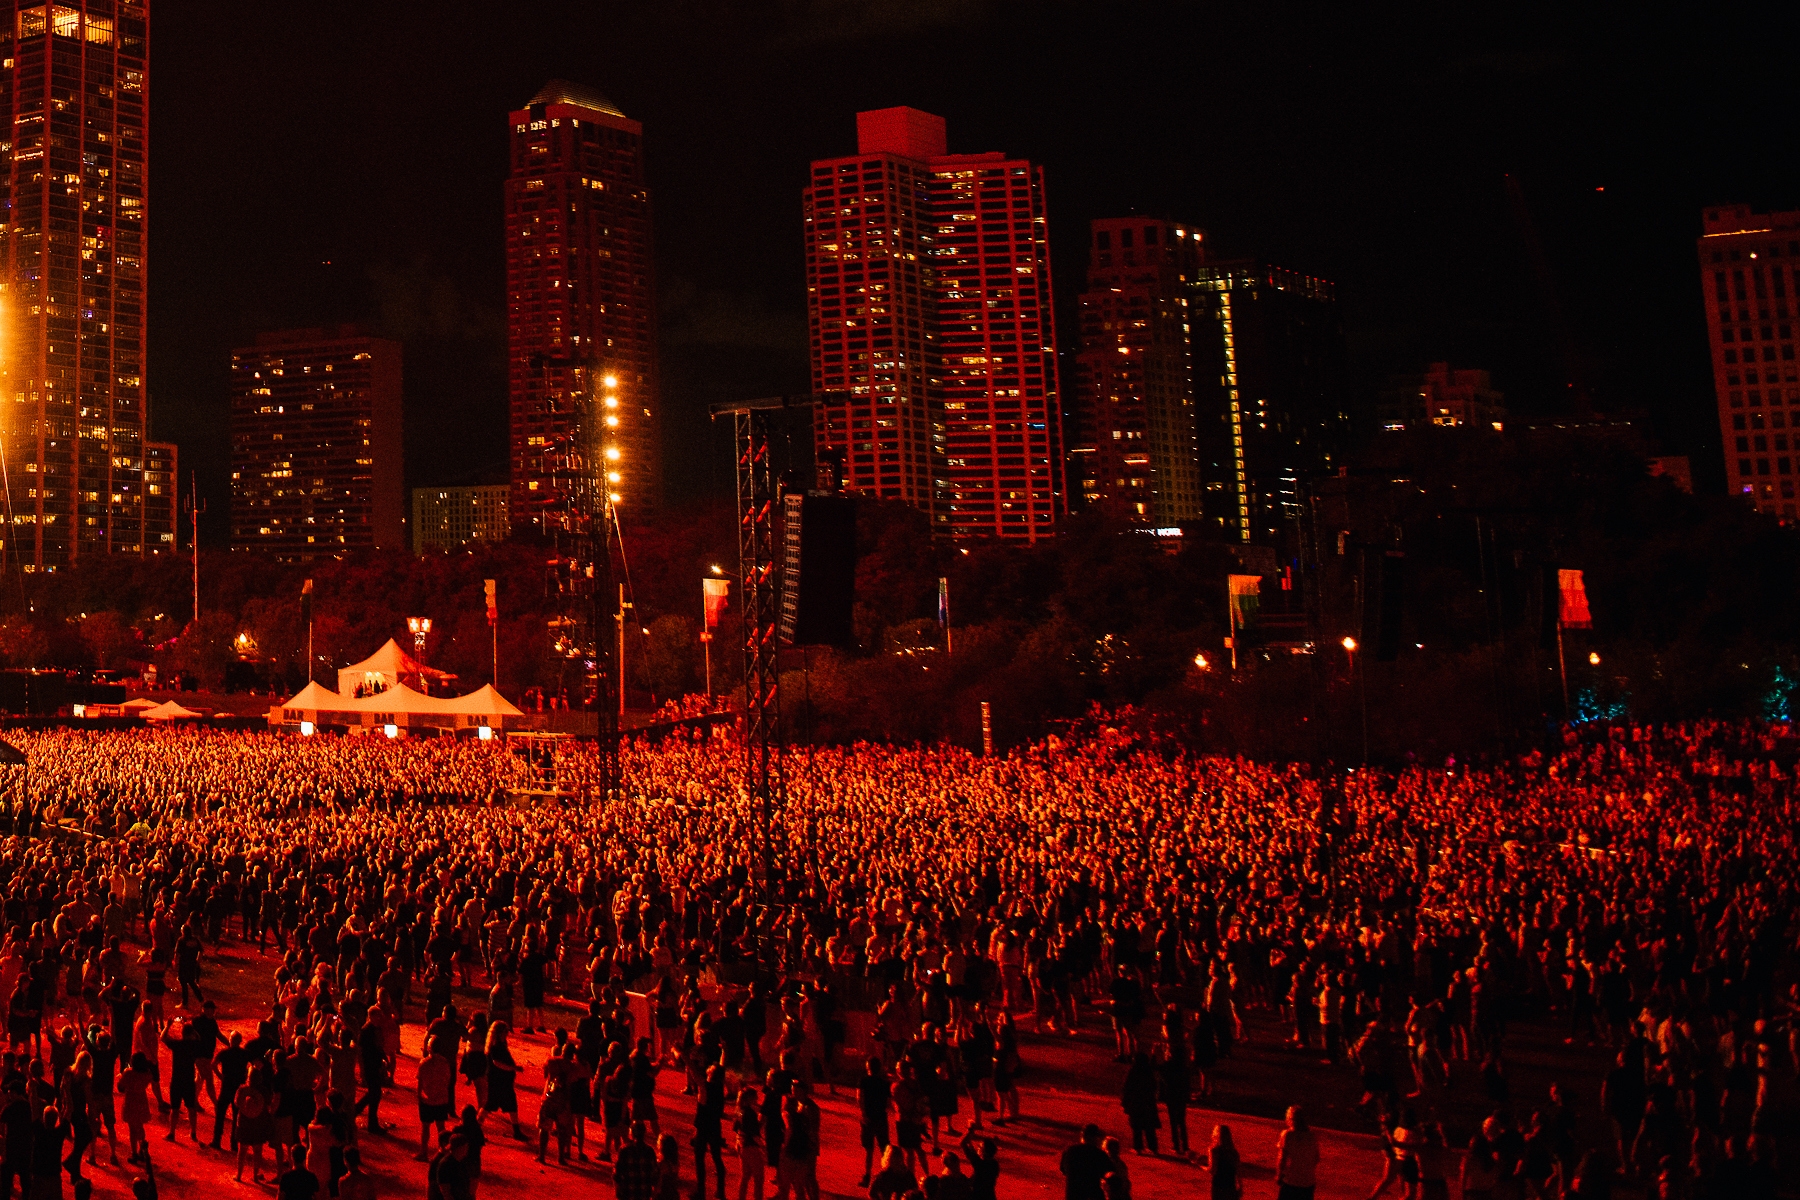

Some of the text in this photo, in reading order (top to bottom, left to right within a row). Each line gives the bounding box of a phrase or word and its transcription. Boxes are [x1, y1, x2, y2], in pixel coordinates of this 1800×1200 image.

[283, 709, 304, 721] BAR
[374, 712, 395, 725] BAR
[467, 715, 489, 727] BAR
